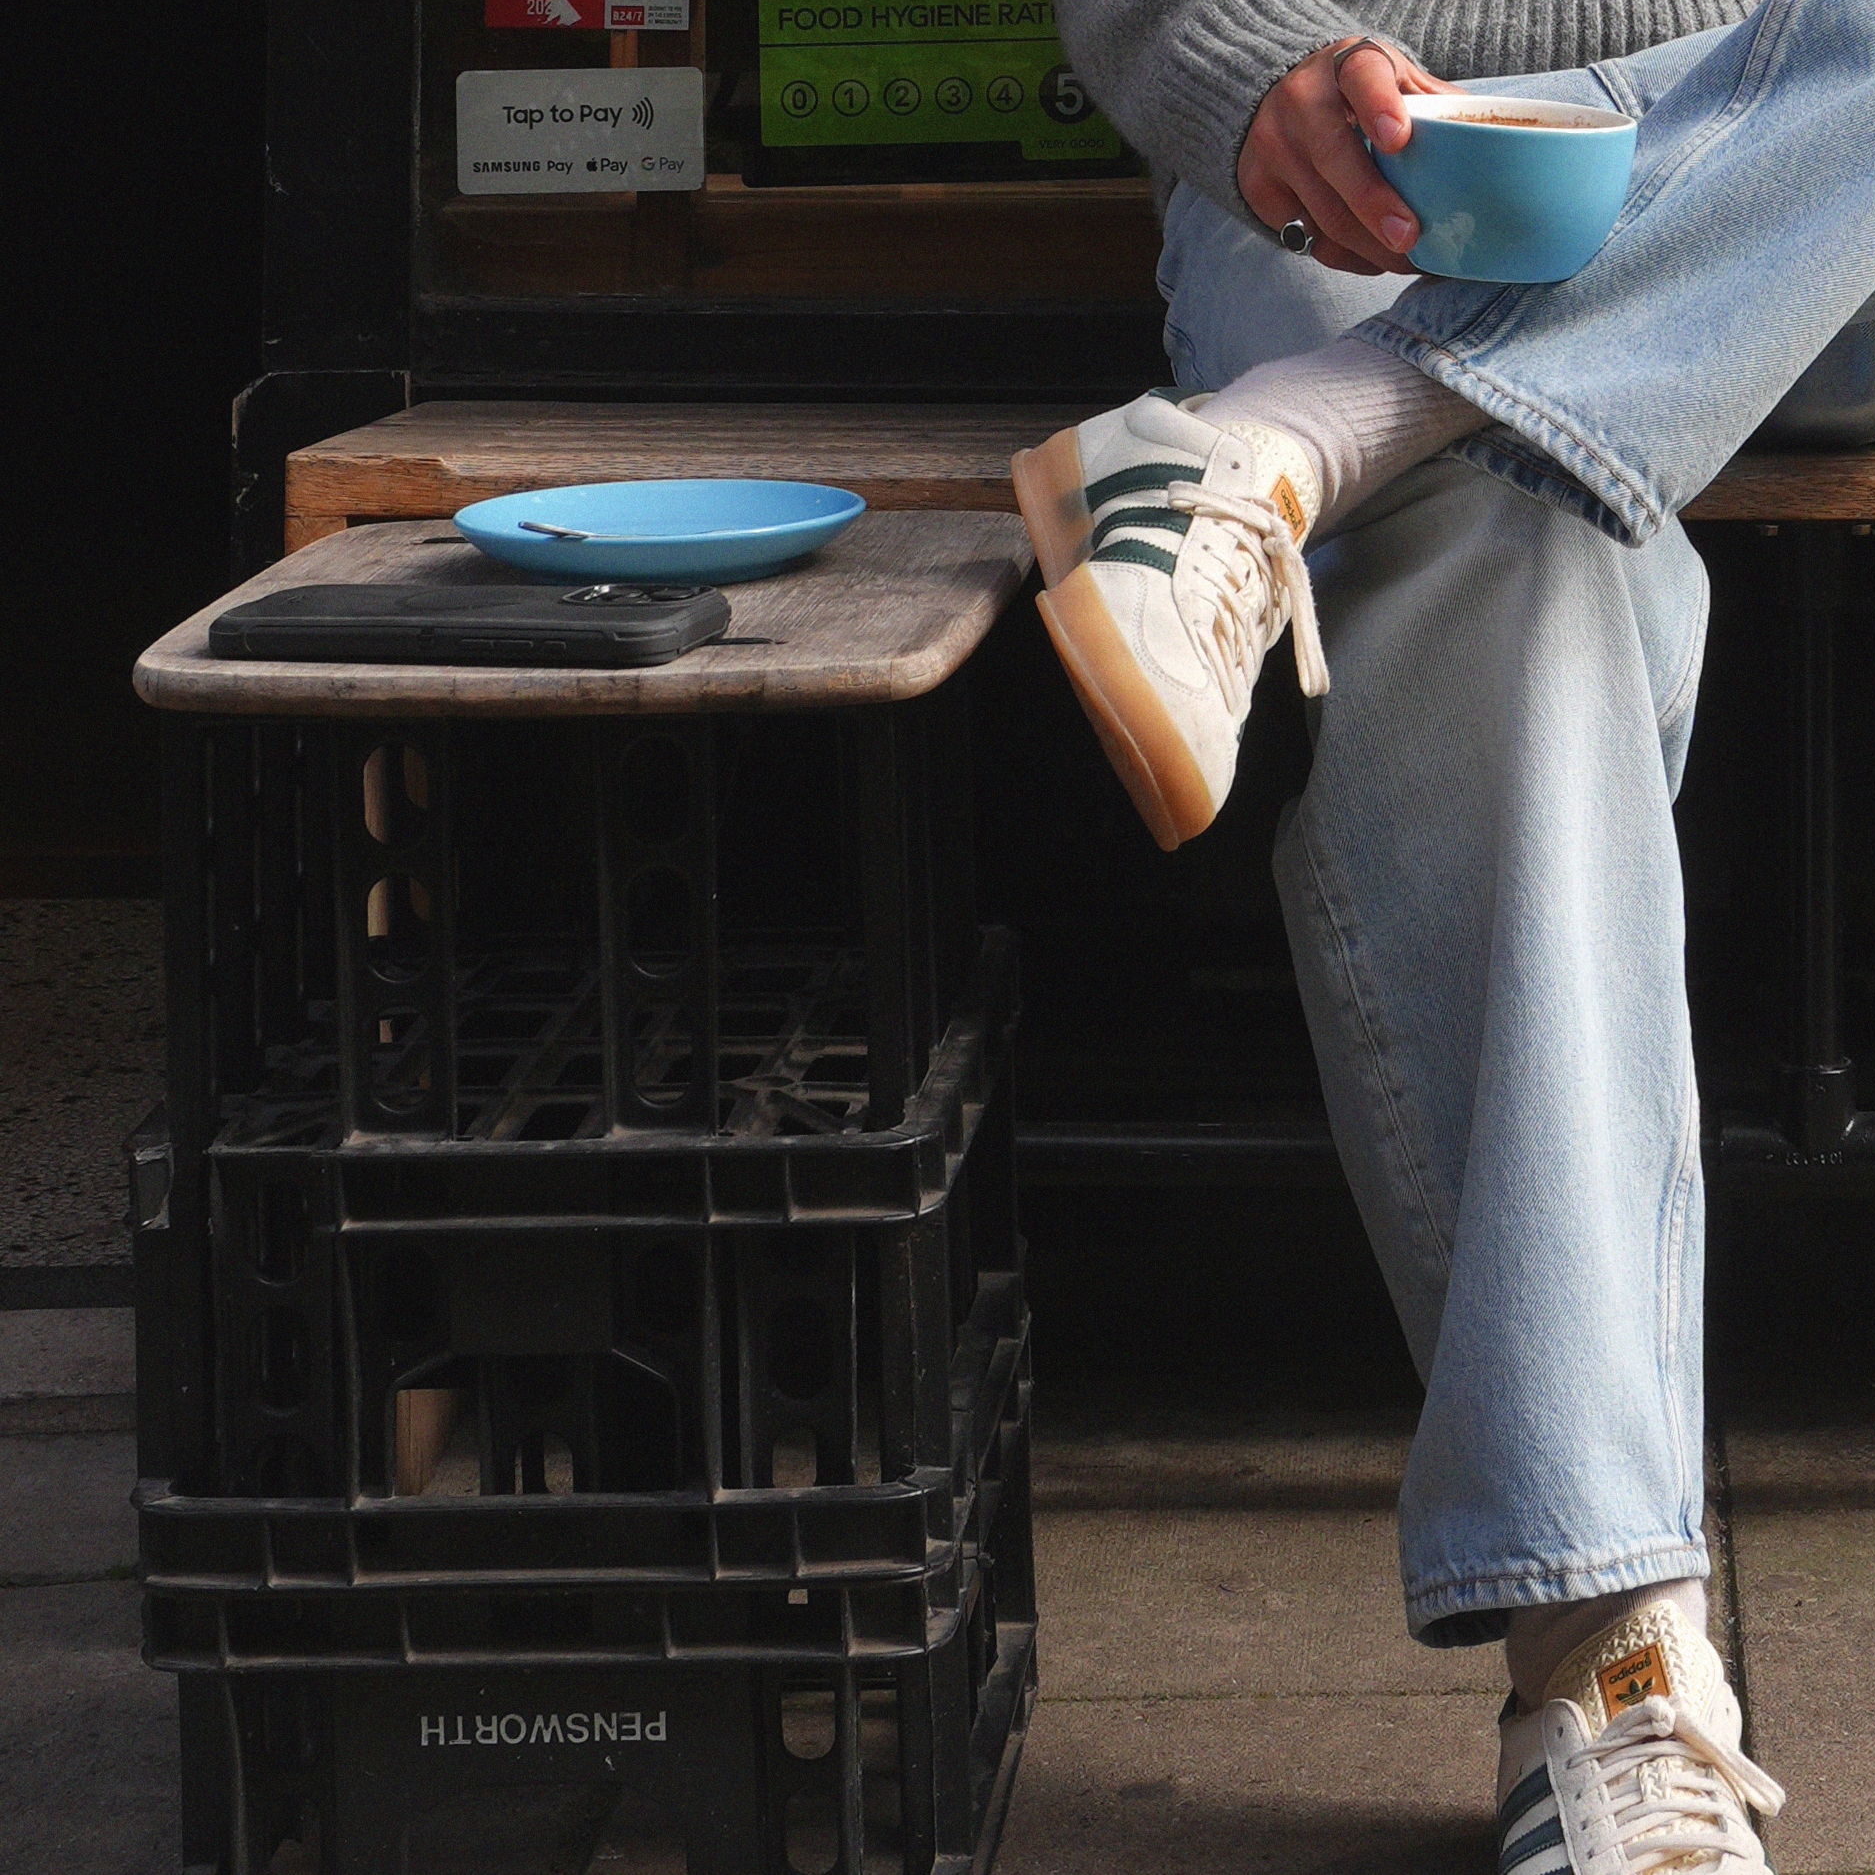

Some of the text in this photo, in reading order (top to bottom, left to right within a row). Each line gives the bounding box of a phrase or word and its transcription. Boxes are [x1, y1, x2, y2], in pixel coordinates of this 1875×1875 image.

[778, 2, 1056, 31] FOOD HYGIENE RATI
[792, 72, 1084, 115] 0 1 2 3 4 5
[503, 104, 623, 130] Tap to Pay
[1039, 138, 1106, 149] VERY GOOD
[472, 160, 540, 173] SAMSUNG
[547, 160, 574, 175] Pay
[601, 158, 628, 175] Pay
[659, 156, 685, 173] Pay
[1280, 489, 1300, 530] adidas
[1609, 1656, 1652, 1684] adidas
[420, 1710, 668, 1747] PENSWORTH
